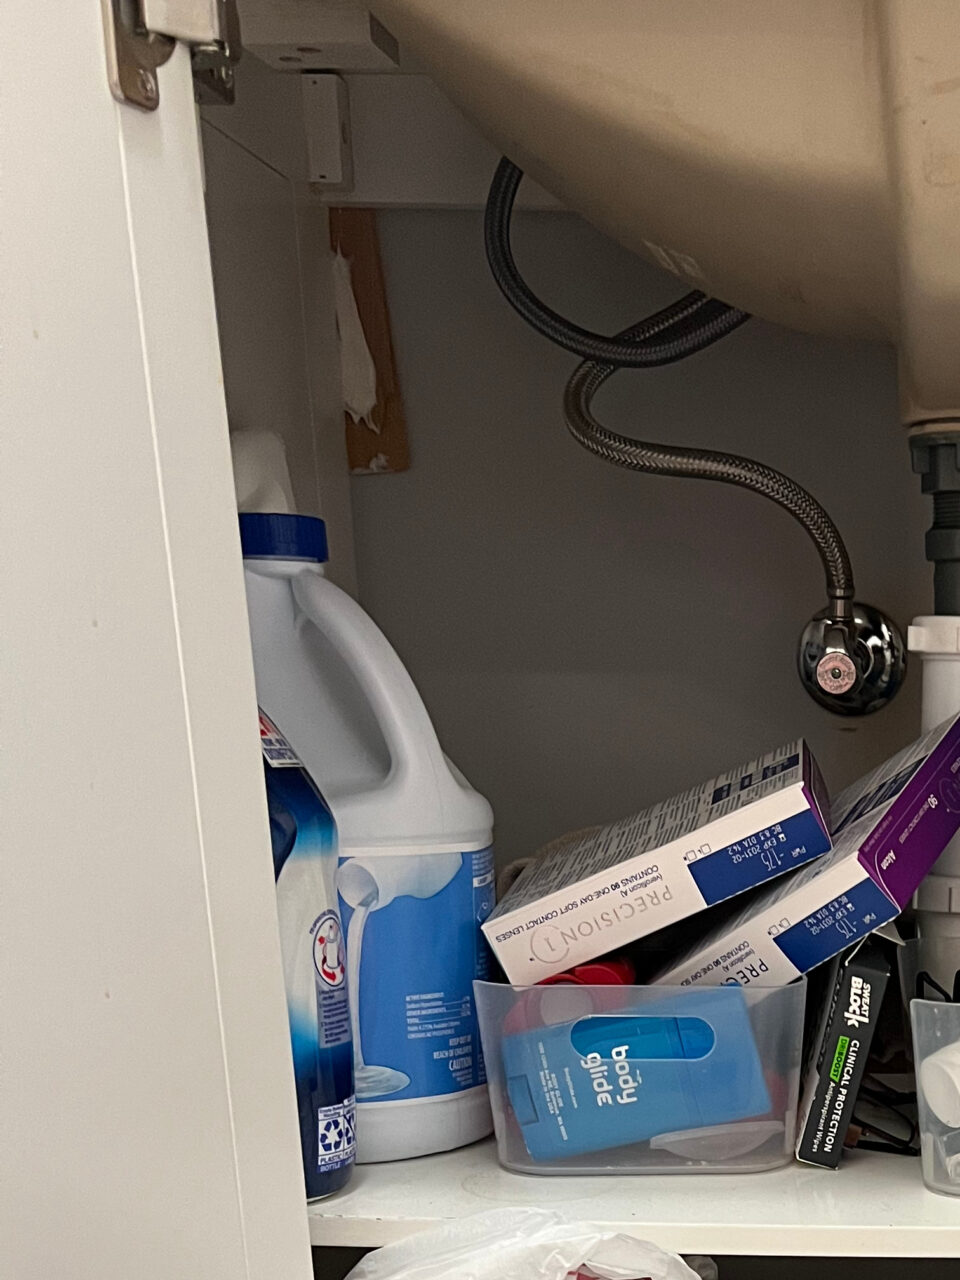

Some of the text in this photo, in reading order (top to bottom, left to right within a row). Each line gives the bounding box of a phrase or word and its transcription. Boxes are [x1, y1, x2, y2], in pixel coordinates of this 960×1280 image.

[927, 794, 938, 809] 90
[743, 836, 757, 846] DIA
[771, 824, 782, 835] BC
[731, 839, 777, 864] EXP 2031-02
[881, 850, 896, 870] Alcon
[495, 864, 659, 942] CONTAINS 90 ONE-DAY SOFT CONTACT LENSES
[560, 885, 673, 946] PRECISION
[719, 940, 750, 962] CONTAINS
[861, 982, 871, 1019] SWEAT
[580, 1052, 614, 1107] glide
[611, 1045, 639, 1104] body
[840, 1039, 860, 1086] CLINICAL
[812, 1082, 835, 1153] Antiperspirant Wipes
[823, 1087, 848, 1153] PROTECTION
[320, 1162, 341, 1172] BOTTLE
